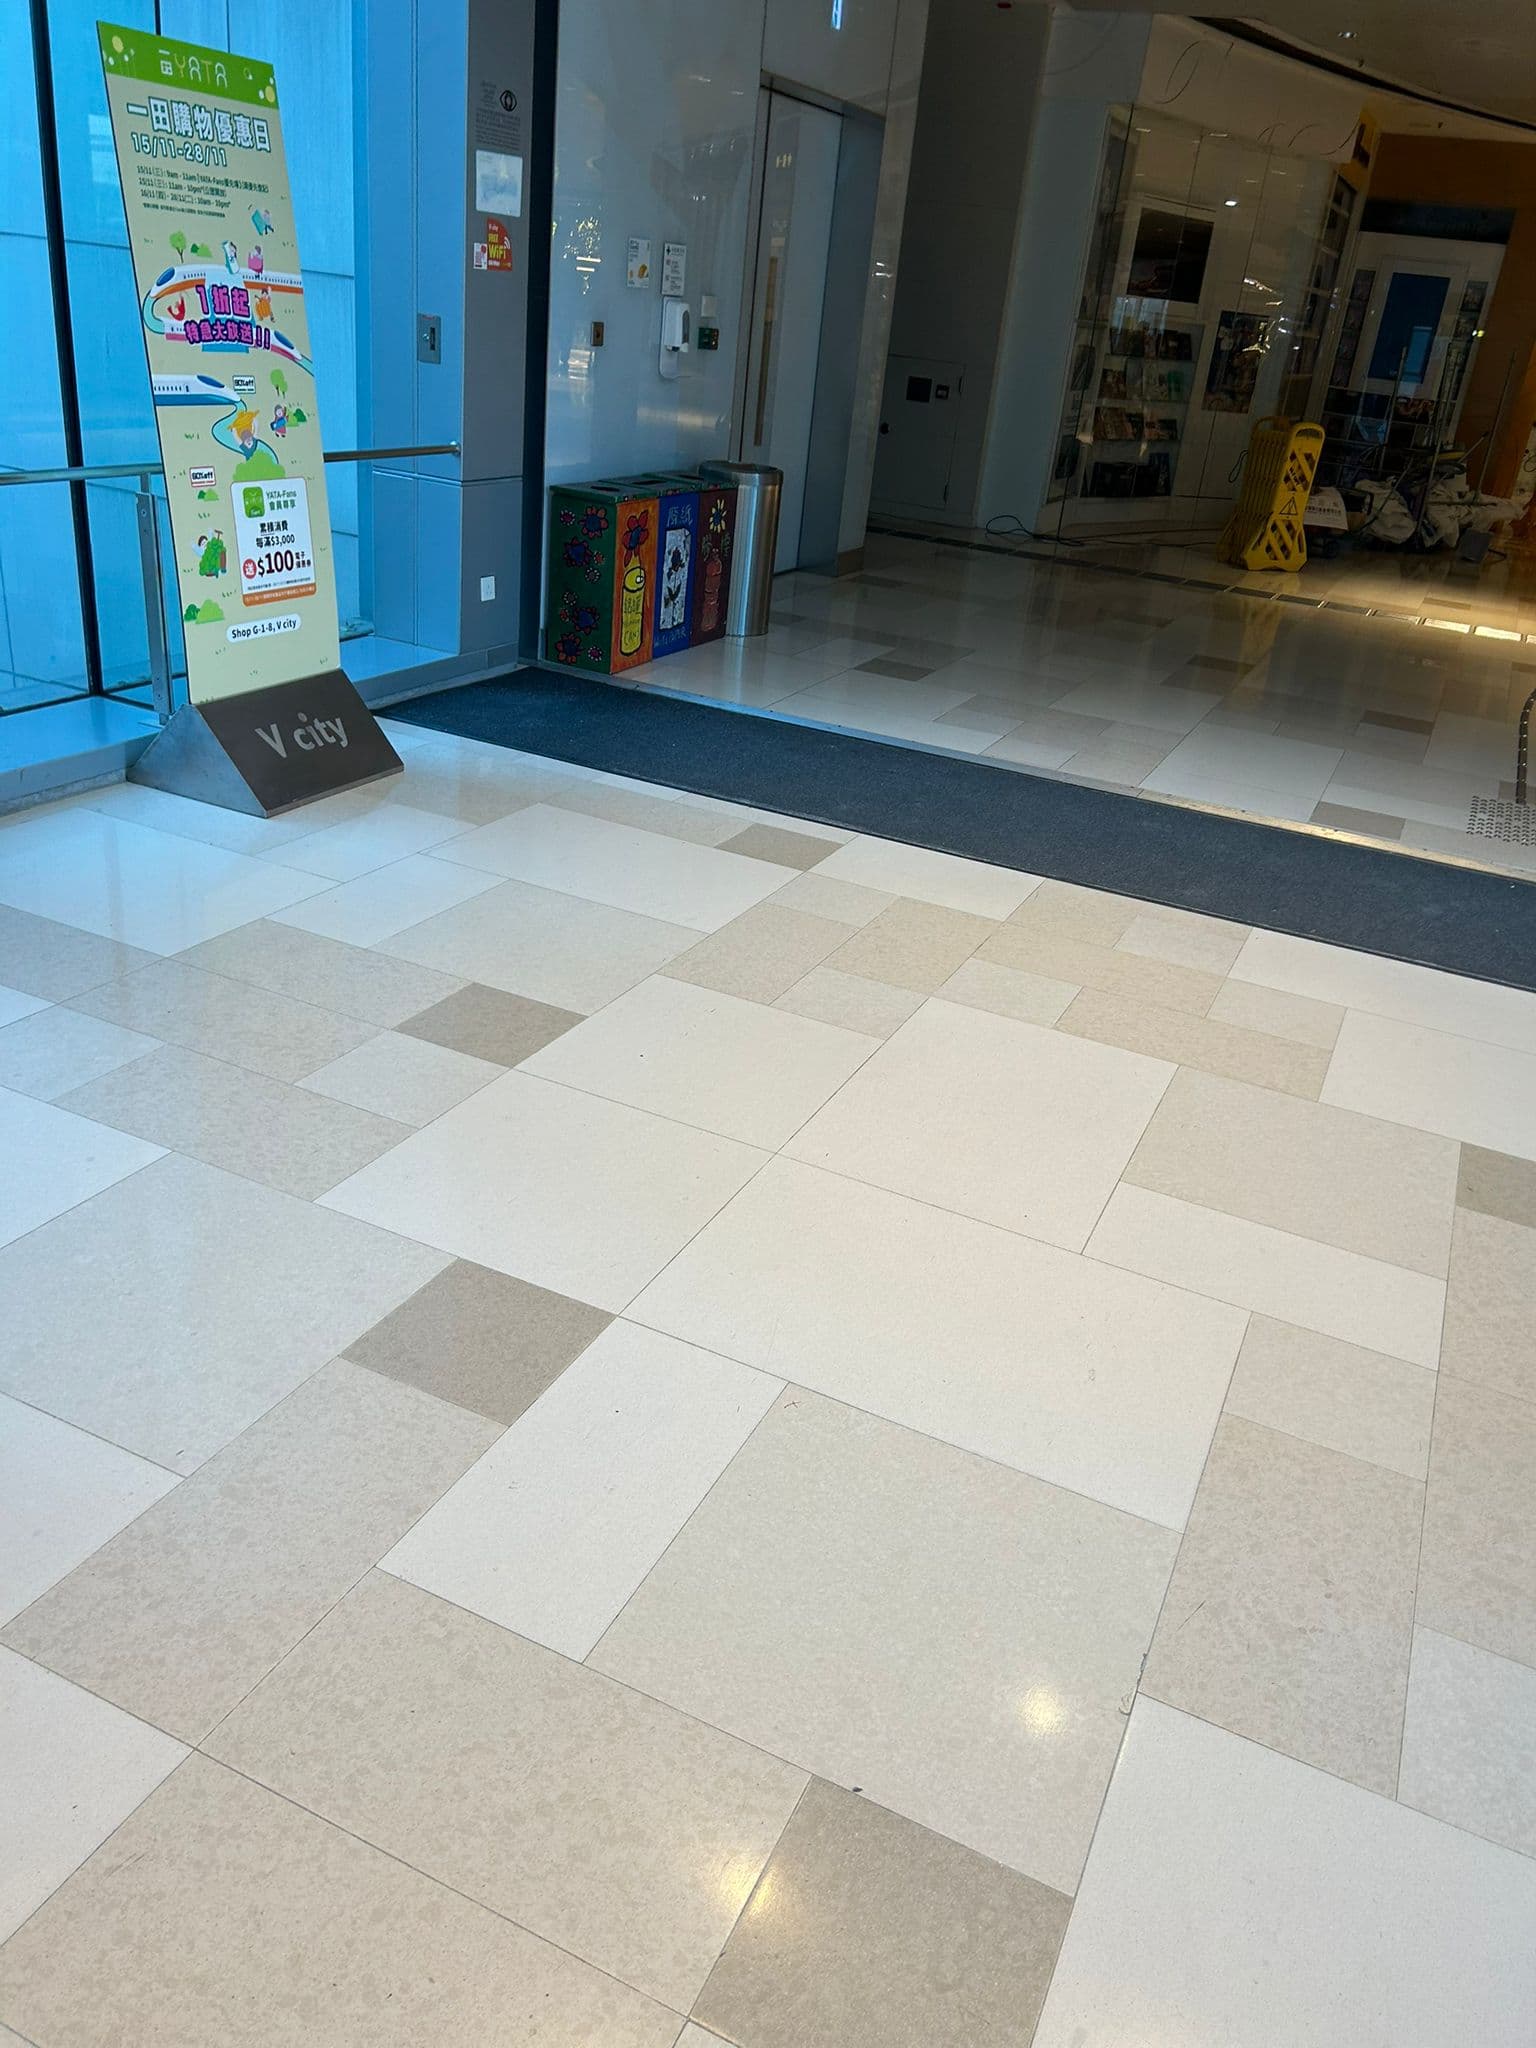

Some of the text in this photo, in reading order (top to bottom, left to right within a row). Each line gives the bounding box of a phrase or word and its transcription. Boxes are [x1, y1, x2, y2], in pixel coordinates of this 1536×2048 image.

[174, 53, 228, 89] YATA
[127, 97, 271, 152] 一田購物優惠日
[131, 132, 227, 167] 15/11-28/11
[195, 283, 251, 319] 1折起
[265, 490, 297, 500] YATA-Fans
[257, 550, 294, 577] $100
[231, 618, 297, 639] Shop G-1-8, V city
[255, 712, 350, 759] V city
